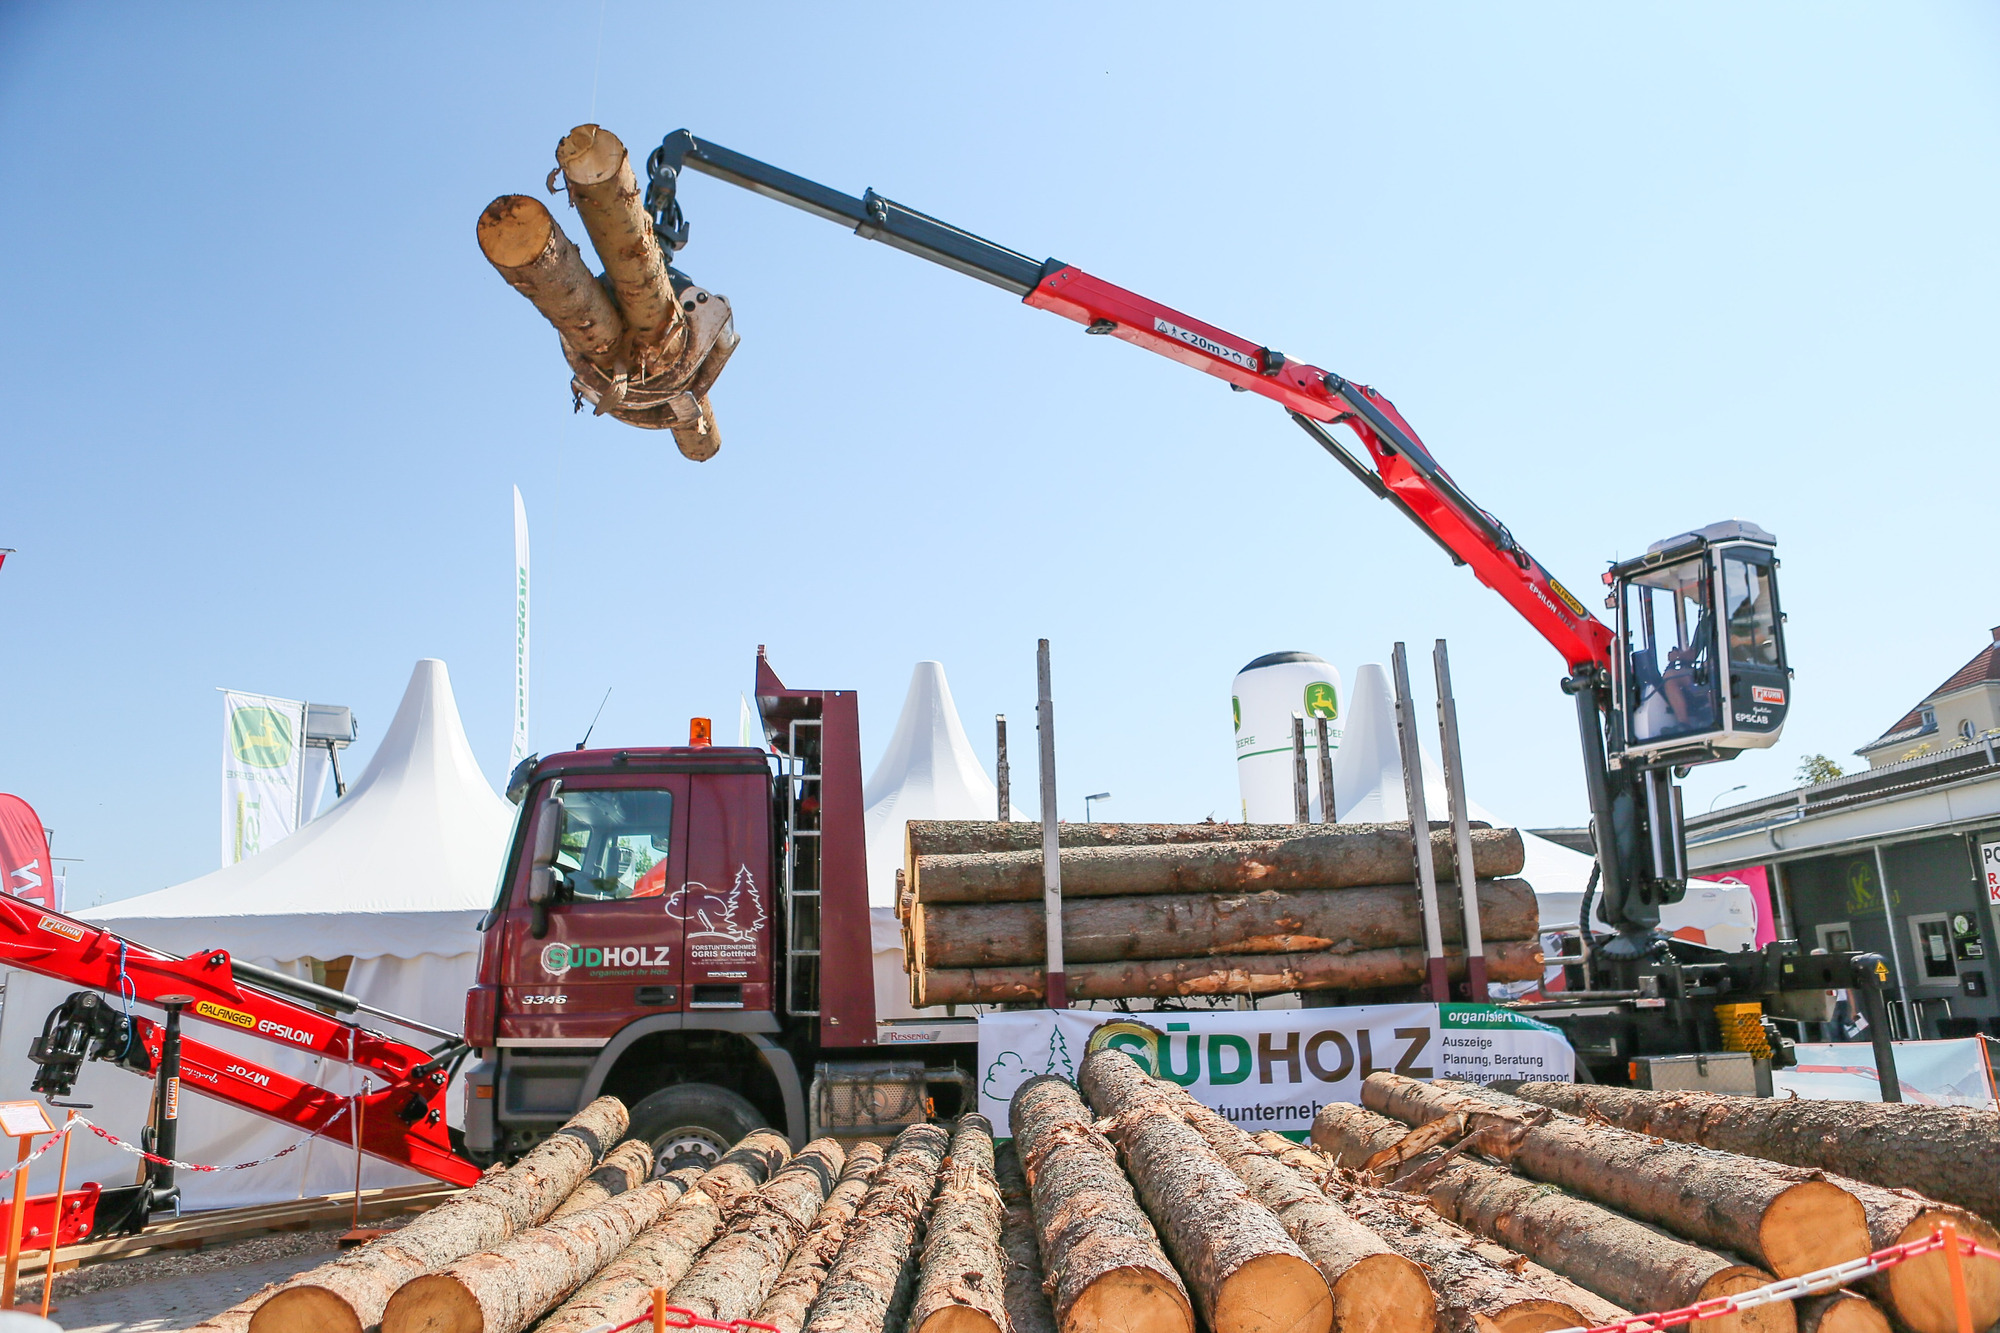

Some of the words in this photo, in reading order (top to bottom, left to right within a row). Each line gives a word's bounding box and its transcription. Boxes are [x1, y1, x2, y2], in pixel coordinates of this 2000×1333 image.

[1529, 582, 1557, 613] EPSILON
[1551, 580, 1582, 613] PALFINGER
[1735, 712, 1769, 725] EPSCAB
[54, 921, 81, 937] KUHN
[550, 944, 670, 968] SÜDHOLZ
[691, 950, 718, 958] OGRIS
[720, 950, 757, 958] Gottfried
[522, 995, 568, 1005] 3346
[199, 1003, 253, 1026] PALFINGER
[1448, 1010, 1512, 1025] organisiert
[258, 1019, 314, 1046] EPSILON
[1442, 1036, 1493, 1050] Auszeige
[1443, 1053, 1492, 1067] Planung,
[1494, 1054, 1544, 1067] Beratung
[225, 1064, 270, 1087] M70F
[168, 1080, 177, 1105] KUHN
